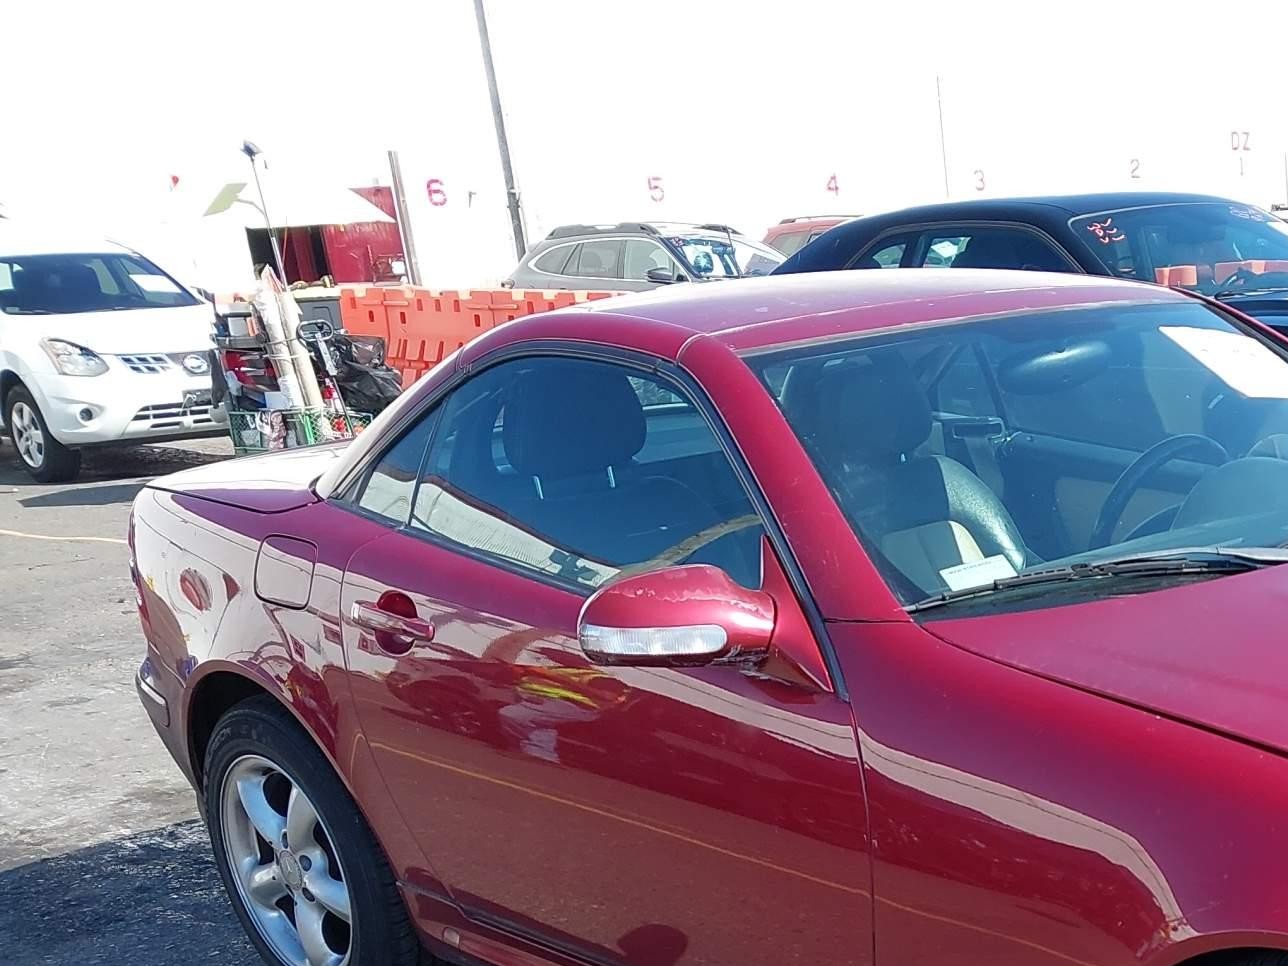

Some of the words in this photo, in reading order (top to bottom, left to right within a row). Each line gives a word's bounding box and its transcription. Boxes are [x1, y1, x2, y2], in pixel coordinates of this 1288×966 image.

[973, 169, 985, 191] 3
[1130, 159, 1141, 179] 2
[426, 178, 447, 207] 6
[647, 176, 665, 203] 5
[827, 172, 840, 196] 4
